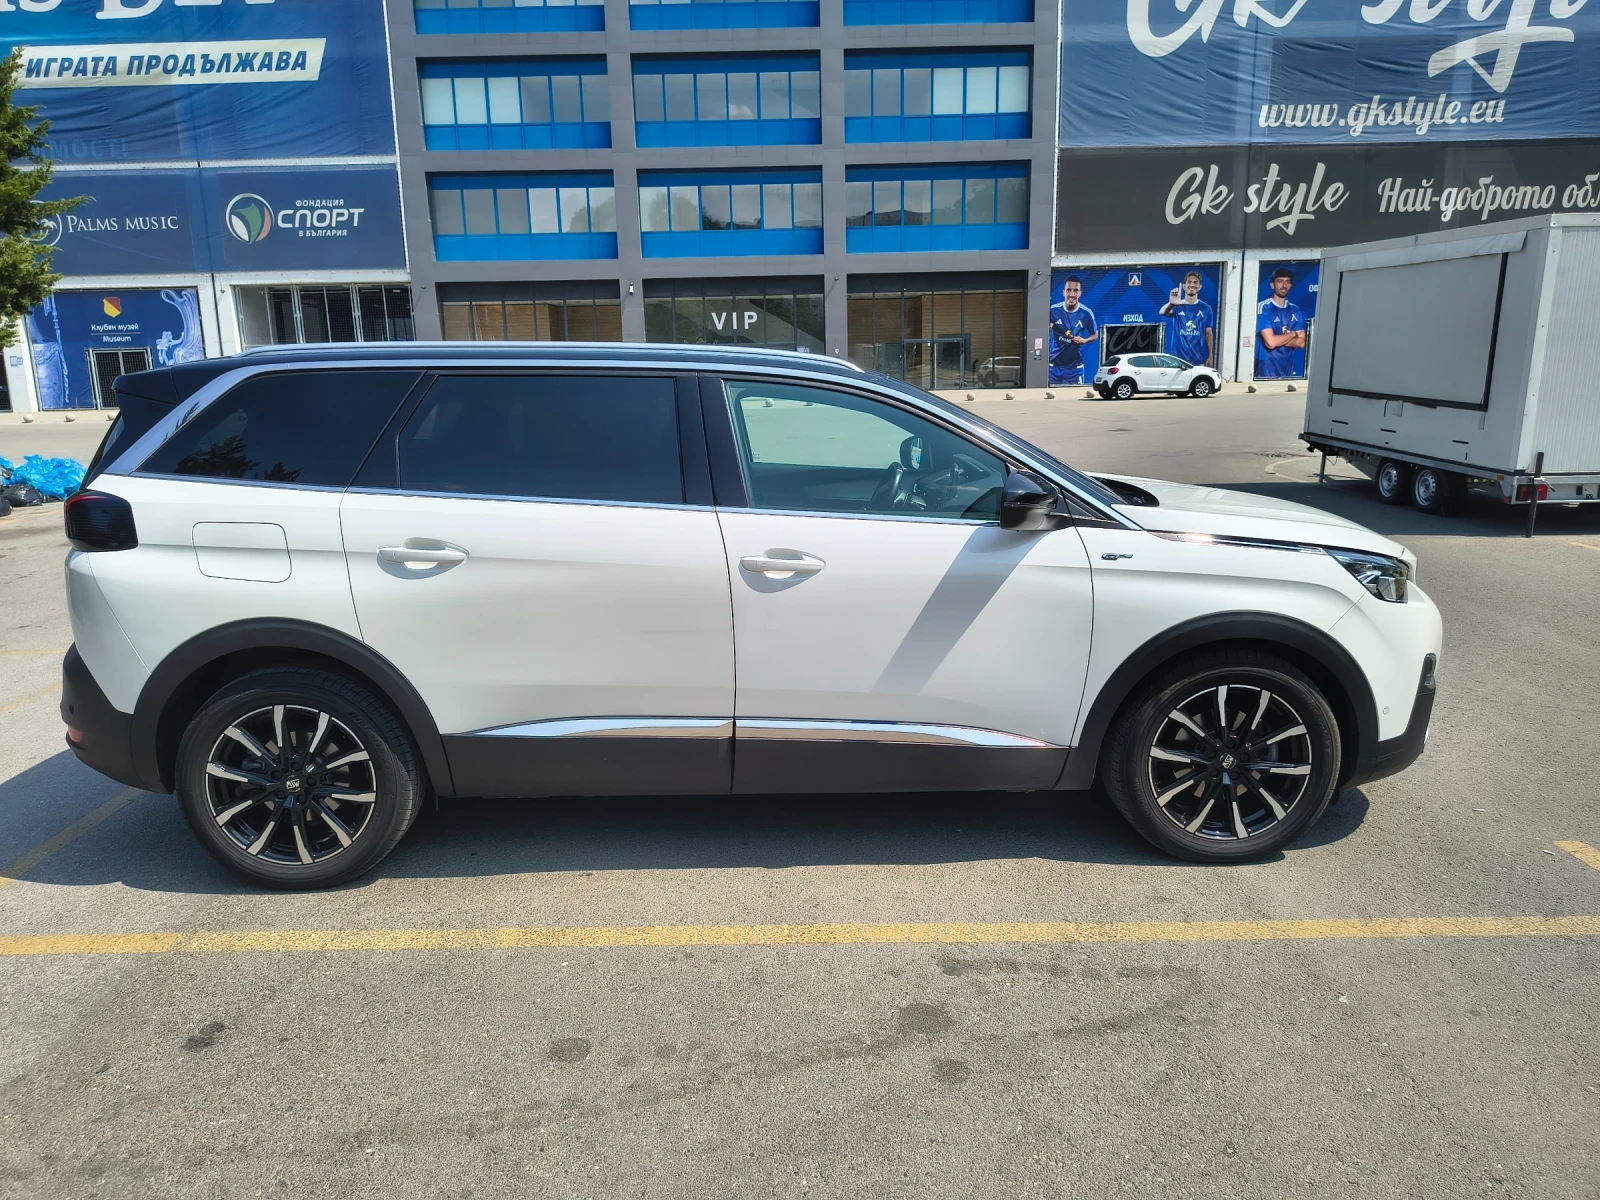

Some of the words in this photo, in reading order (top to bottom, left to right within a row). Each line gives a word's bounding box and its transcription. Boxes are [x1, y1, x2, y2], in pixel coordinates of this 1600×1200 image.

[25, 55, 118, 79] ИГРАТА
[126, 50, 308, 78] ПРОДЪЛЖАВА
[1257, 93, 1505, 137] www.gkstyle.eu
[295, 199, 344, 207] ФОНДАЦИЯ
[1165, 164, 1234, 225] Gk
[1243, 162, 1350, 236] style
[277, 208, 365, 228] СПОРТ
[306, 229, 348, 237] БЪЛГАРИЯ
[711, 311, 758, 331] VIP
[1123, 313, 1144, 323] ИЗХОД
[102, 335, 132, 343] Museum
